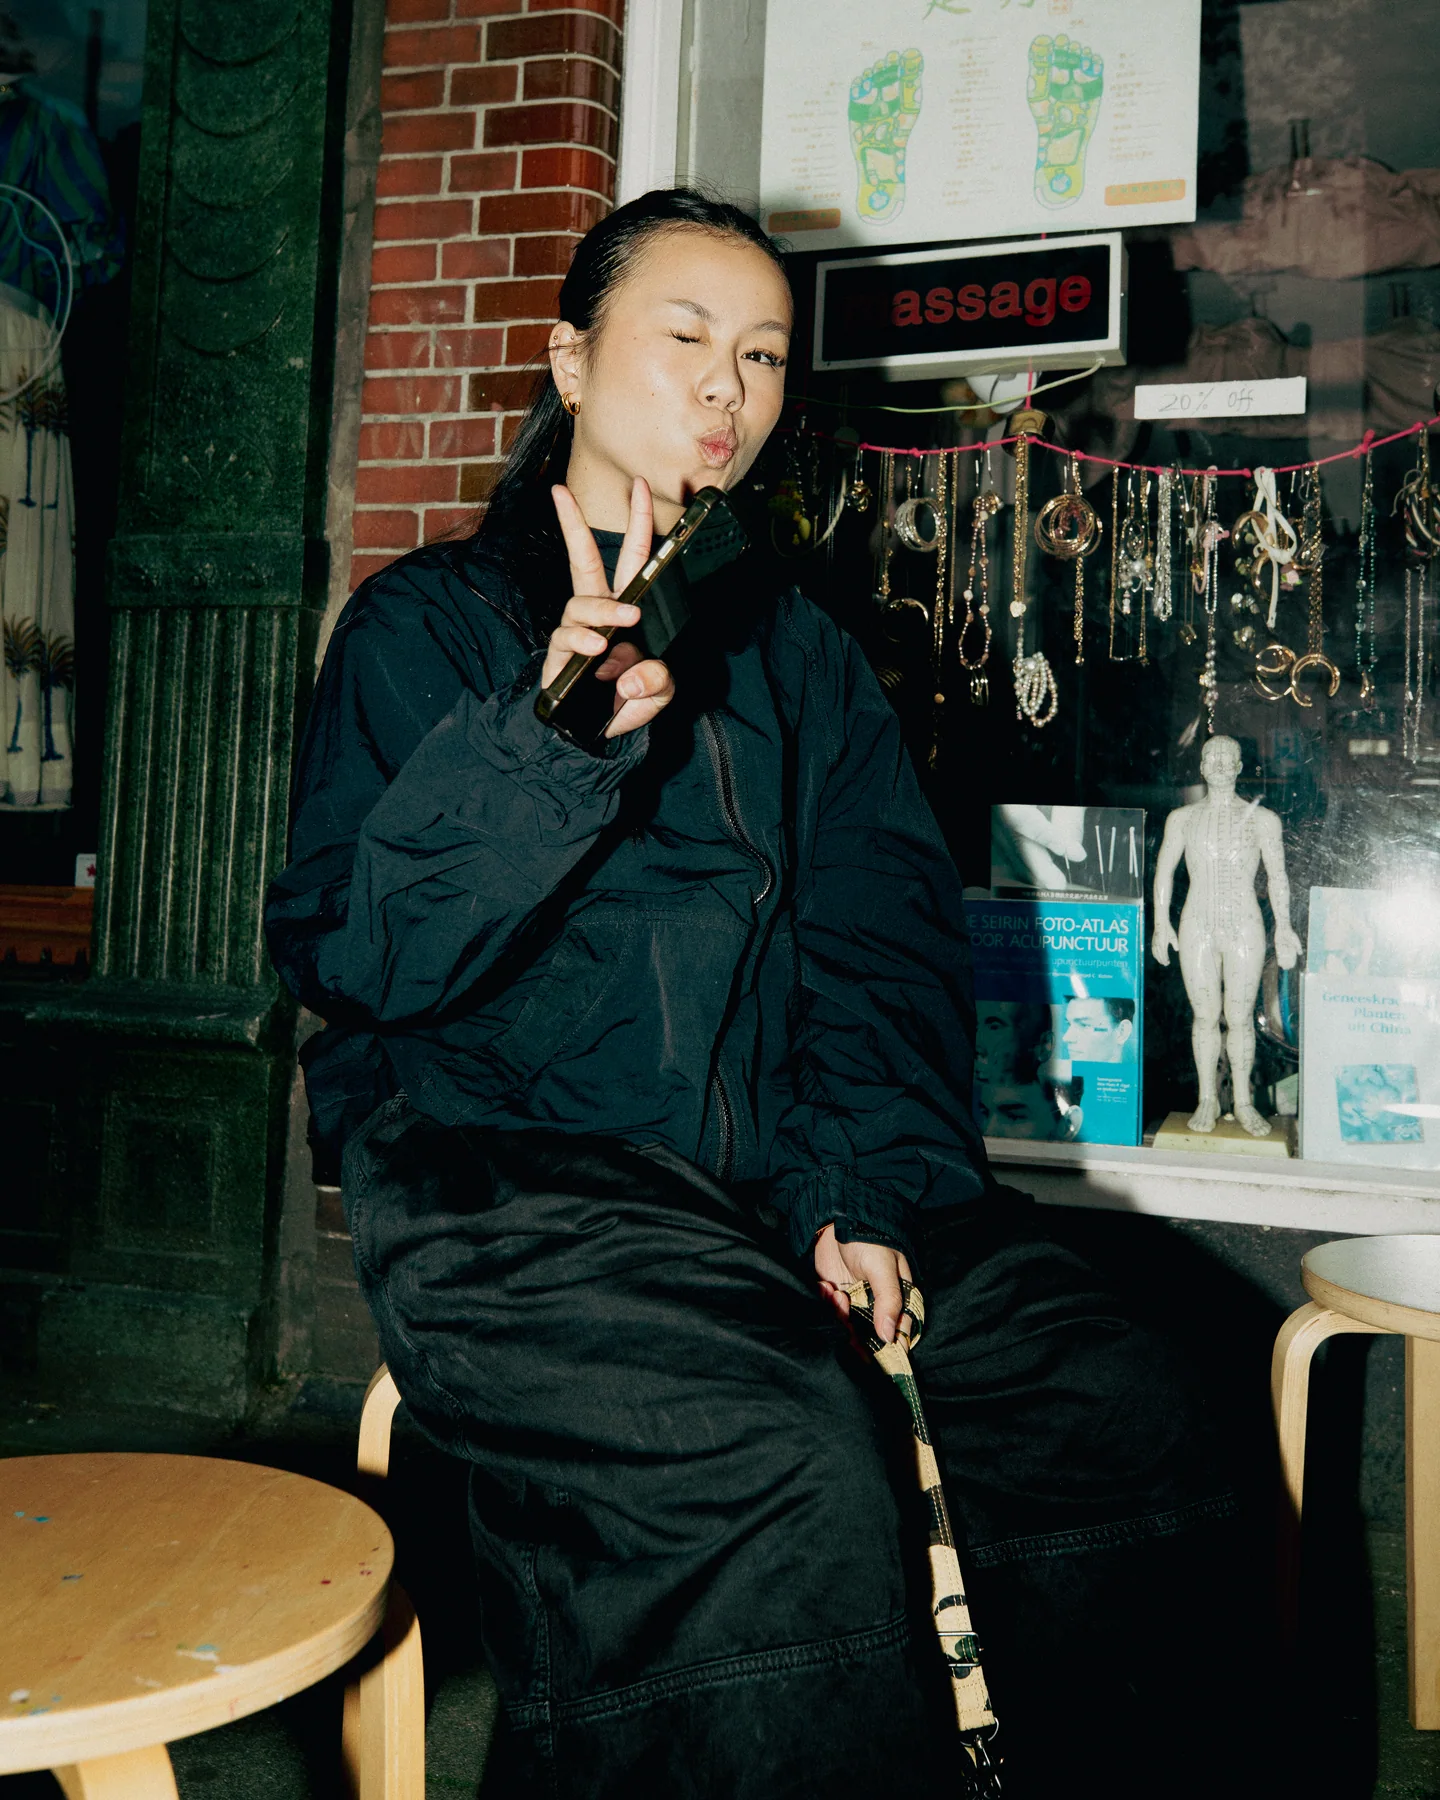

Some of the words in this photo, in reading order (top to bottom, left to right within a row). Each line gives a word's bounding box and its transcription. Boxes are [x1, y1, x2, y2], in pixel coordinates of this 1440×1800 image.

[843, 273, 1093, 329] assage
[1158, 387, 1214, 415] 20%
[981, 915, 1029, 930] SEIRIN
[1034, 916, 1129, 935] FOTO-ATLAS
[968, 932, 1004, 947] OOR
[1009, 934, 1129, 953] ACUPUNCTUUR
[1370, 1021, 1411, 1034] China
